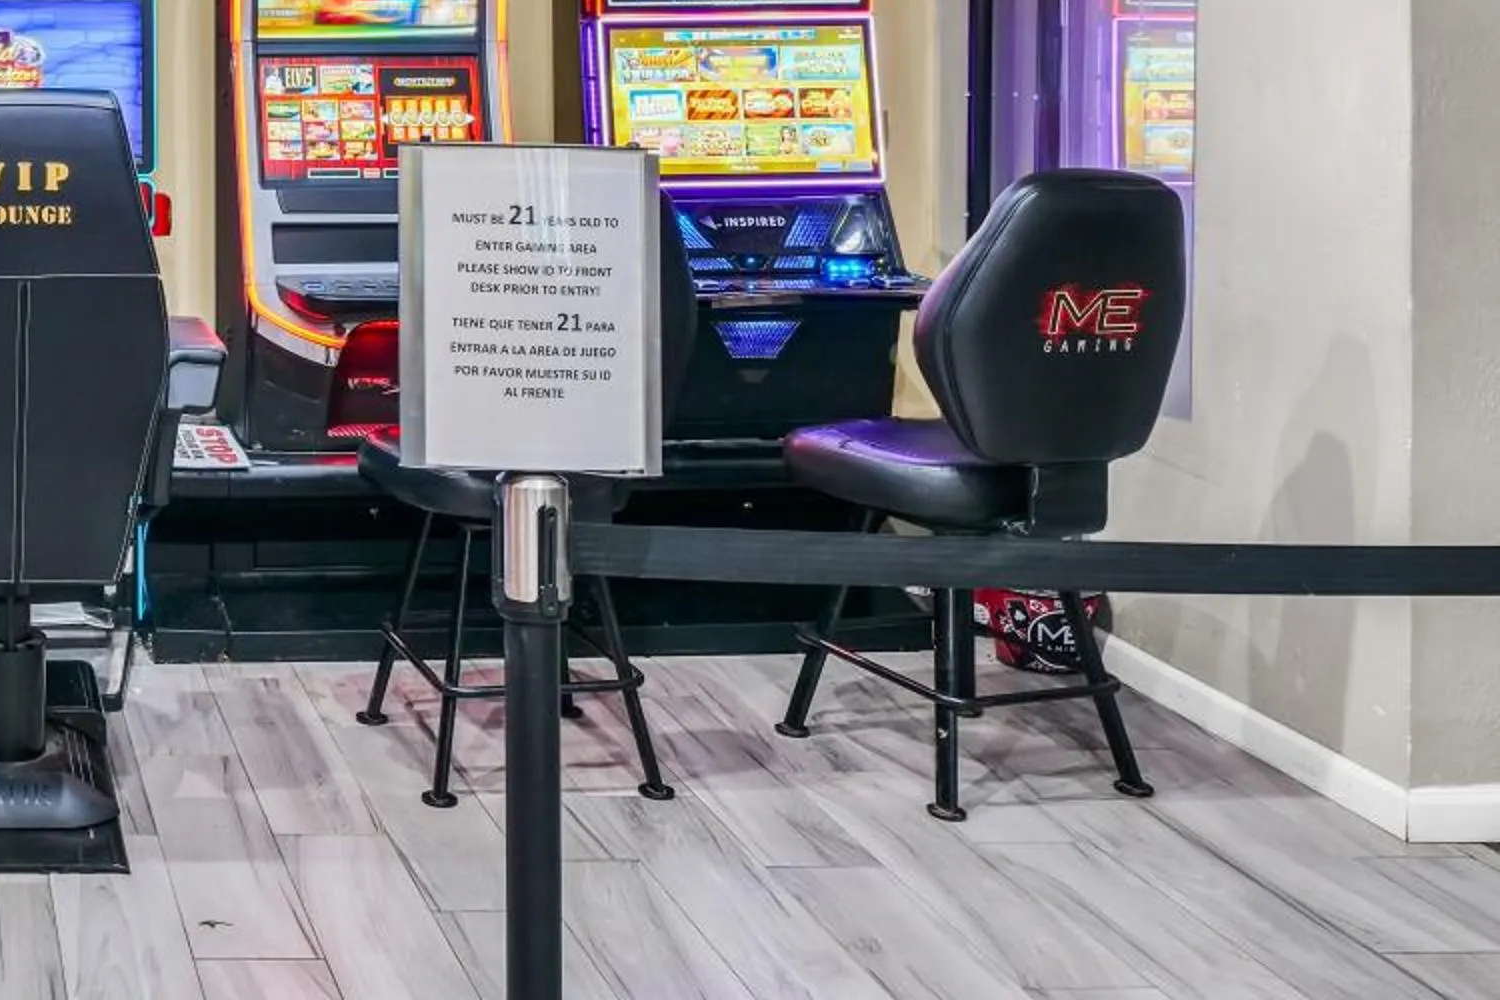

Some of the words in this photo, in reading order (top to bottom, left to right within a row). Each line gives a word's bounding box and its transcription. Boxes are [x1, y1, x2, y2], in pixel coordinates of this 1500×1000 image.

[284, 67, 313, 88] ELVIS
[452, 212, 487, 224] MUST
[491, 214, 505, 225] BE
[509, 205, 535, 226] 21
[542, 215, 576, 227] YEAS
[580, 217, 601, 228] OLD
[604, 217, 619, 229] TO
[724, 216, 787, 227] INSPIRED
[475, 240, 513, 252] ENTER
[568, 243, 597, 255] AREA
[457, 262, 499, 275] PLEASE
[503, 264, 539, 275] SHOW
[542, 265, 555, 277] ID
[558, 266, 573, 277] TO
[575, 266, 612, 278] FRONT
[471, 282, 501, 294] DESK
[503, 283, 539, 295] PRIOR
[542, 284, 557, 296] TO
[1047, 289, 1143, 335] ME
[452, 317, 485, 329] TIENE
[489, 318, 515, 331] QUE
[518, 319, 553, 331] TENER
[557, 313, 583, 332] 21
[585, 321, 615, 333] PARA
[450, 342, 497, 354] ENTRAR
[500, 343, 510, 354] A
[512, 344, 527, 356] LA
[529, 344, 560, 356] AREA
[563, 346, 578, 357] DE
[579, 346, 617, 359] JUEGO
[1043, 337, 1133, 353] GAMING
[455, 365, 479, 377] POR
[483, 365, 523, 378] FAVOR
[526, 367, 579, 380] MUESTRE
[582, 368, 597, 381] SU
[599, 369, 611, 381] ID
[504, 386, 518, 398] AL
[521, 387, 565, 399] FRENTE
[196, 428, 238, 465] STOP
